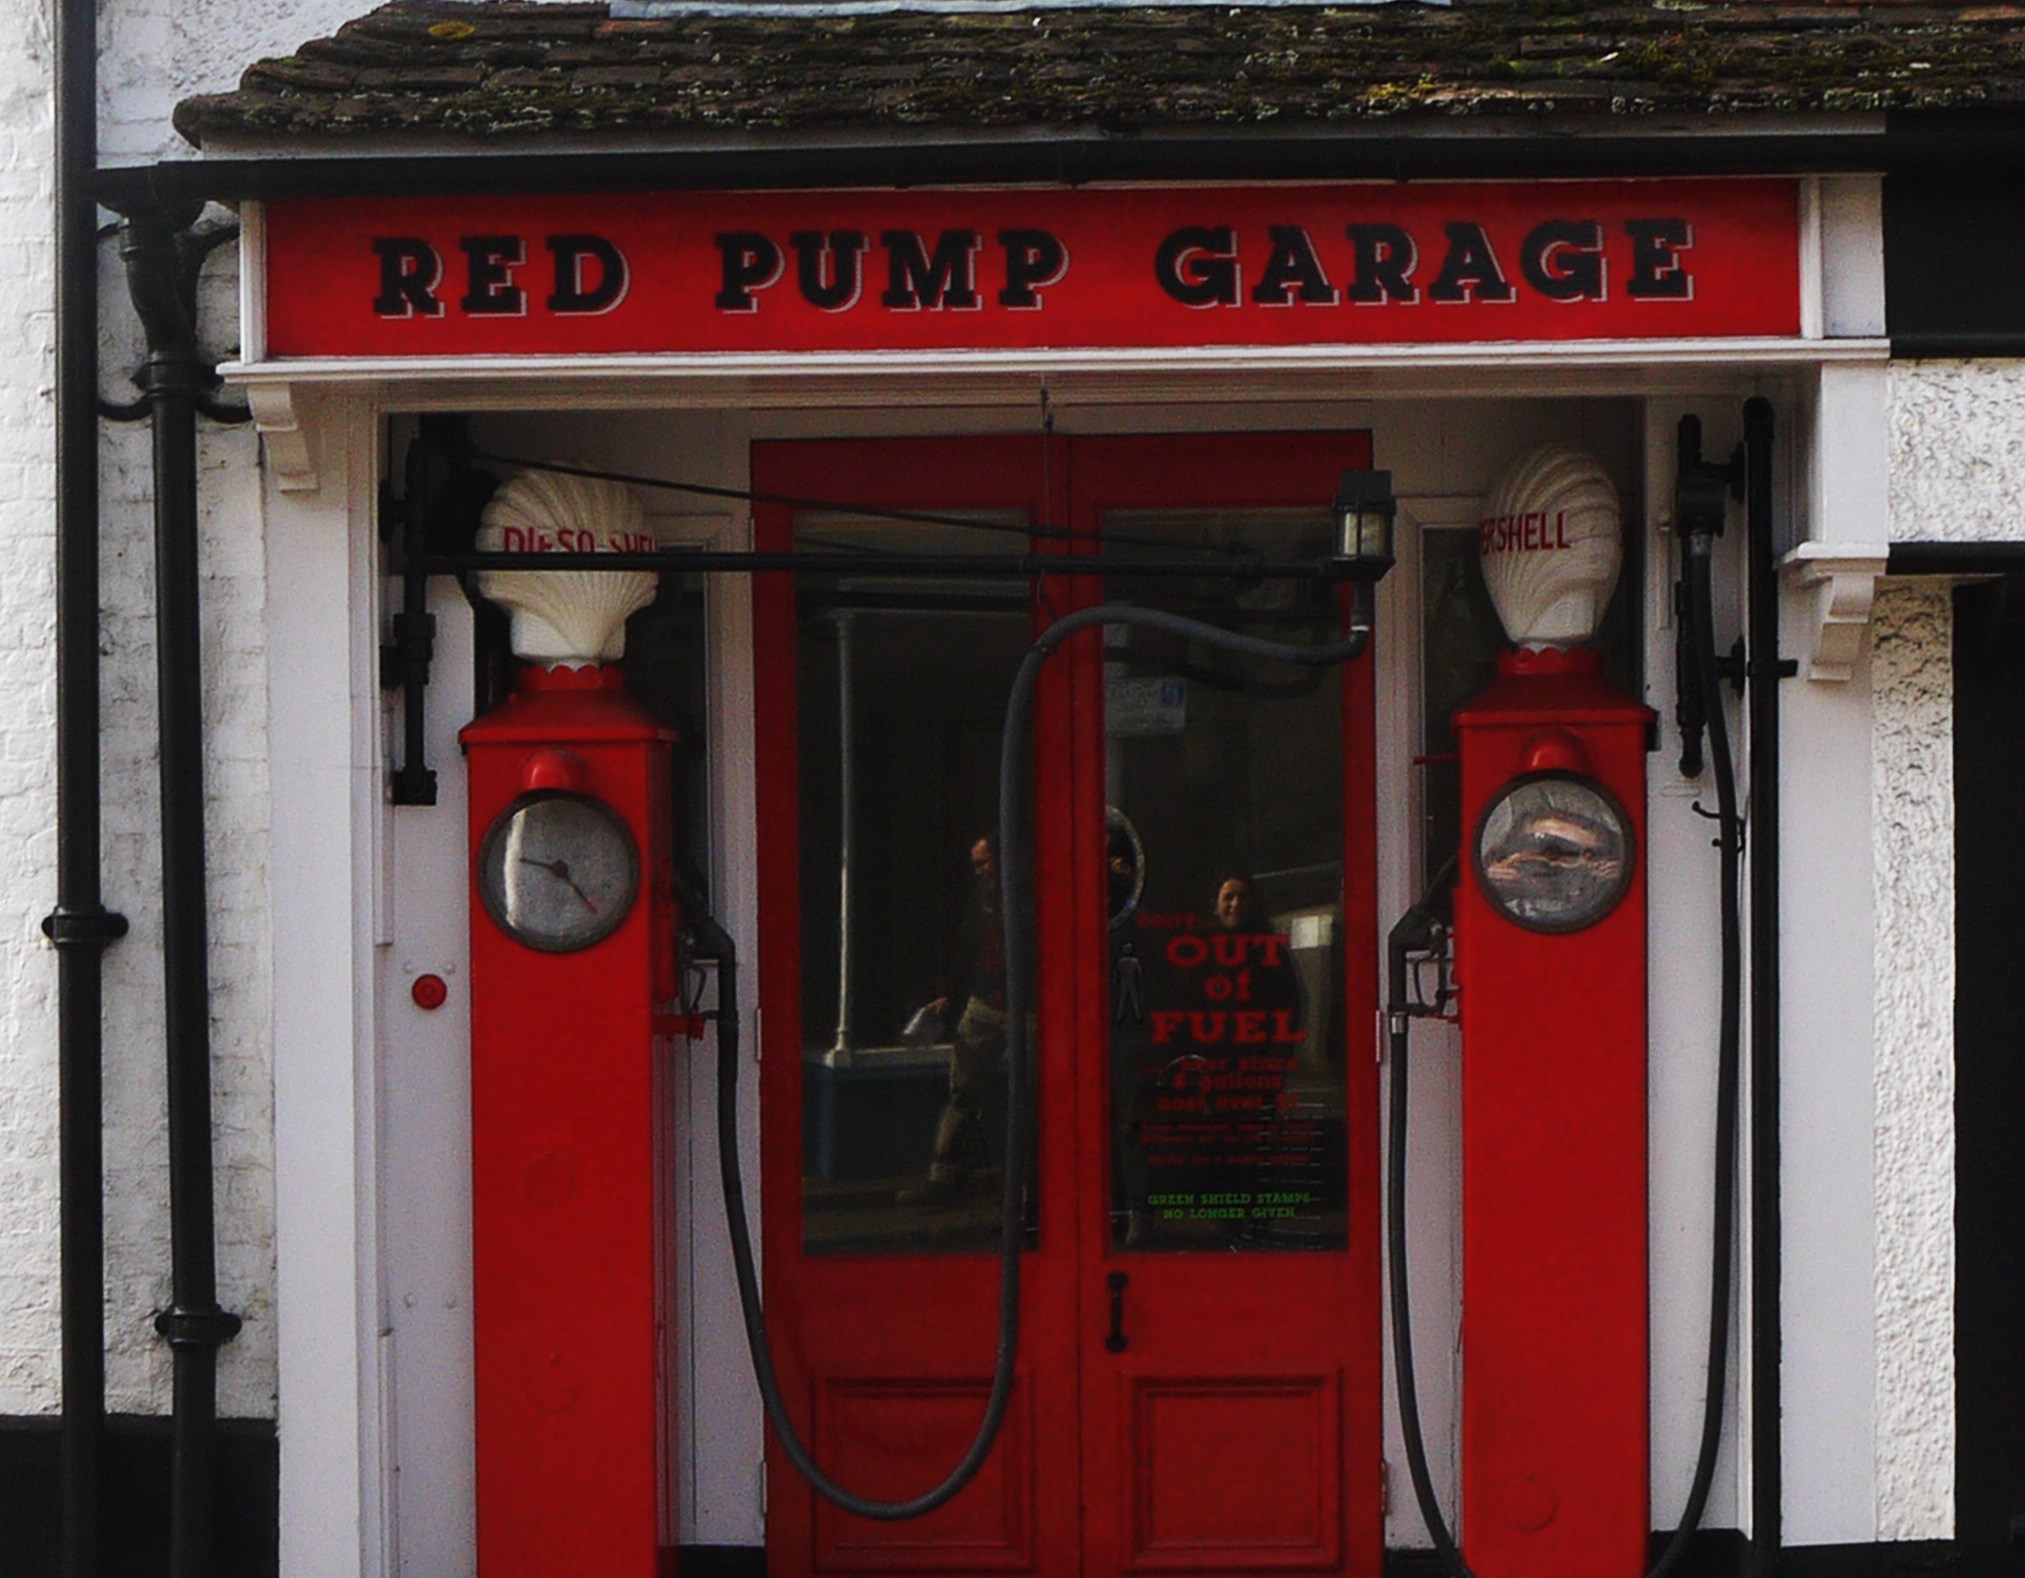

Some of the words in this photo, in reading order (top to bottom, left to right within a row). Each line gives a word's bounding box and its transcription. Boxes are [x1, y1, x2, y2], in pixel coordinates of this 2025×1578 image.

[372, 234, 630, 319] RED
[714, 228, 1070, 313] PUMP
[1154, 218, 1695, 309] GARAGE
[1165, 934, 1290, 969] OUT
[1203, 967, 1253, 1002] of
[1149, 1010, 1308, 1045] FUEL
[1147, 1192, 1195, 1206] GREEN
[1200, 1192, 1252, 1206] SHIELD
[1256, 1191, 1311, 1205] STAMPS
[1162, 1207, 1184, 1220] NO
[1190, 1207, 1246, 1220] LONGER
[1252, 1206, 1296, 1219] GIVEN
